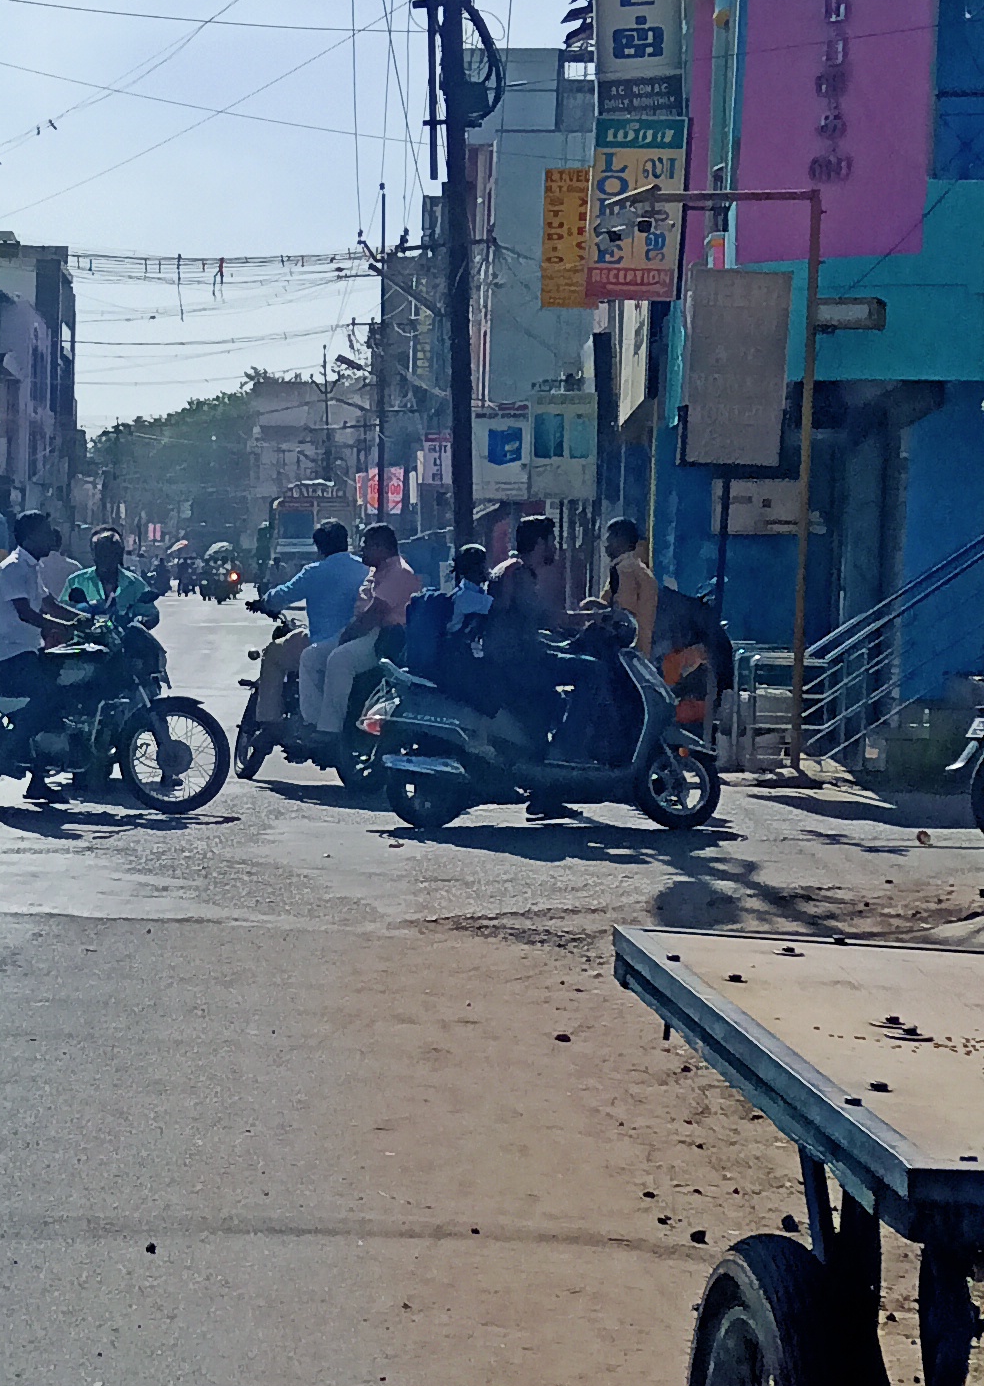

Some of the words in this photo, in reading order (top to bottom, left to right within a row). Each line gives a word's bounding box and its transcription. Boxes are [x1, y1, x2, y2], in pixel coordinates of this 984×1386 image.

[633, 95, 675, 107] MONTHLY
[606, 122, 676, 146] மீரா
[594, 152, 629, 265] LOE
[591, 269, 670, 284] RECEPTION
